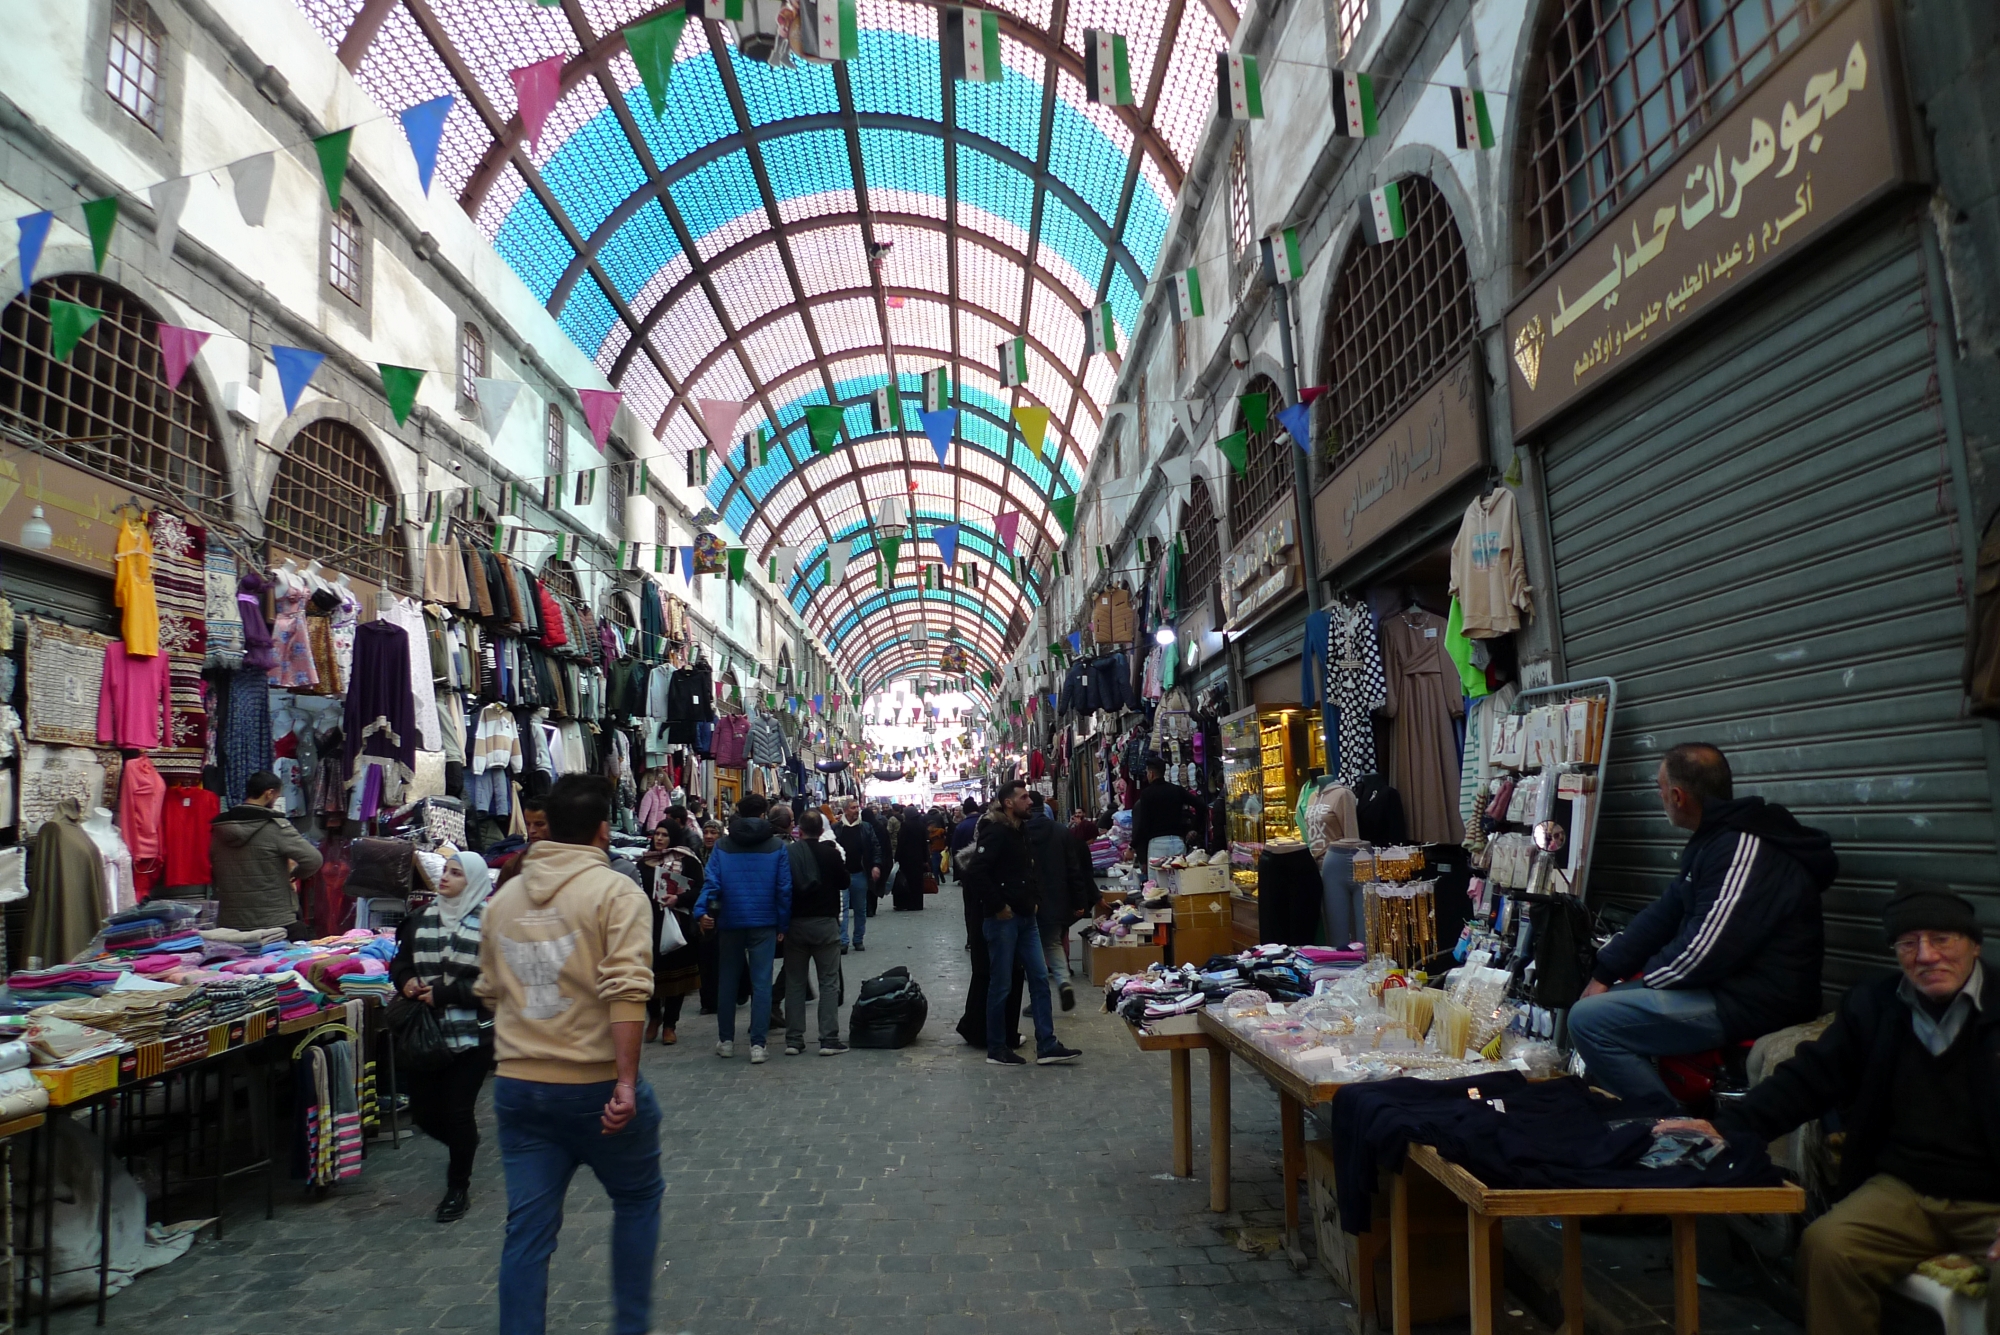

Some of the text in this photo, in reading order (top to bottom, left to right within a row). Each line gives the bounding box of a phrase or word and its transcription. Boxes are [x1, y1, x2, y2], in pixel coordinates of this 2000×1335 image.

[1550, 40, 1868, 338] مجوهرات حديد
[1761, 171, 1813, 253] أكرم
[1712, 242, 1744, 280] عبد
[1745, 231, 1756, 264] و
[1623, 300, 1662, 343] حديد
[1665, 260, 1710, 322] الحليم
[1402, 390, 1447, 490] أزياء
